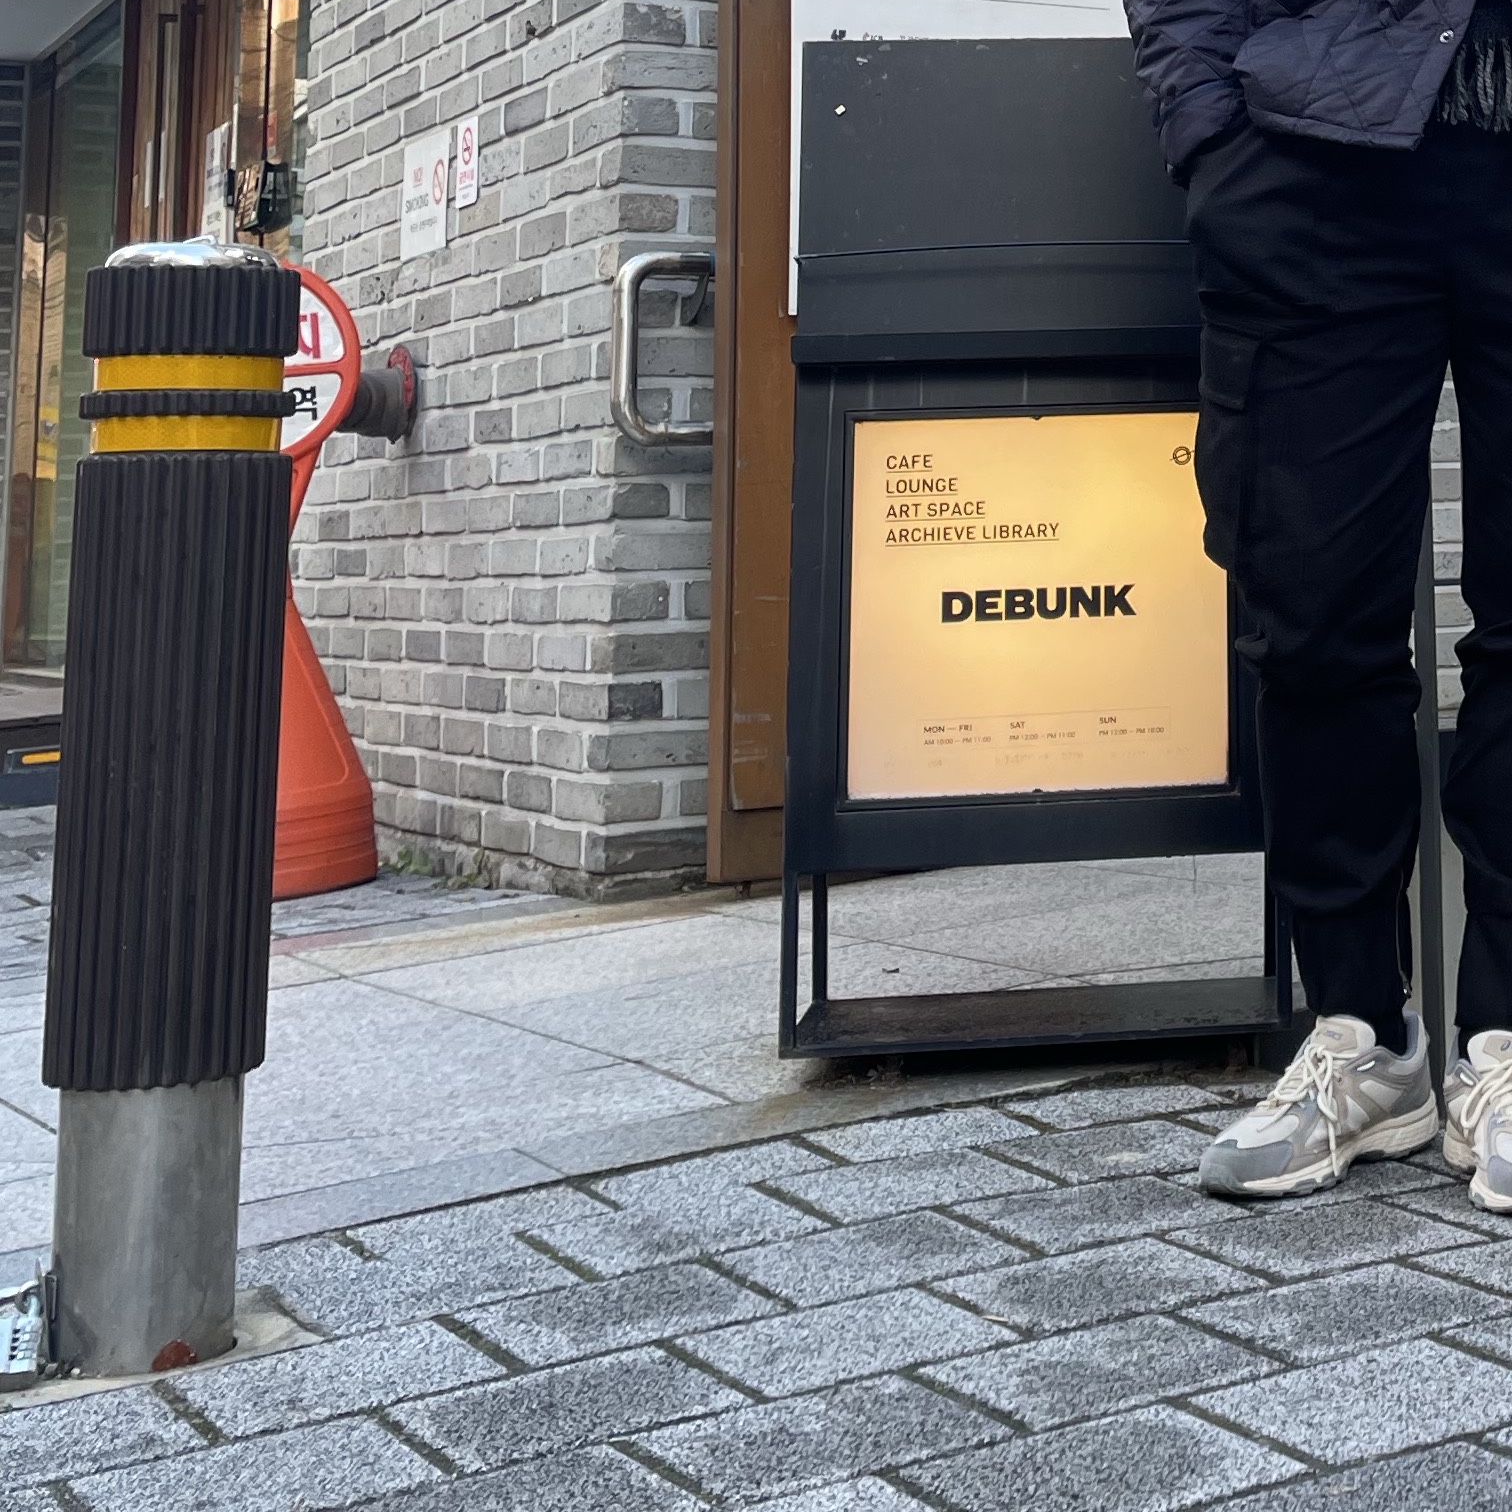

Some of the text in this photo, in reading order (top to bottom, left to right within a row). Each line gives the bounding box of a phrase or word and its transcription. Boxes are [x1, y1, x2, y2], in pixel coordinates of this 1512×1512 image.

[886, 454, 933, 470] CAFE
[886, 478, 958, 494] LOUNGE
[886, 501, 986, 519] ART SPACE
[885, 523, 1059, 544] ARCHIEVE LIBRARY
[941, 584, 1136, 623] DEBUNK
[1009, 721, 1025, 729] SAT
[1099, 716, 1117, 724] SUN
[923, 725, 945, 734] MON
[959, 724, 972, 732] FRI
